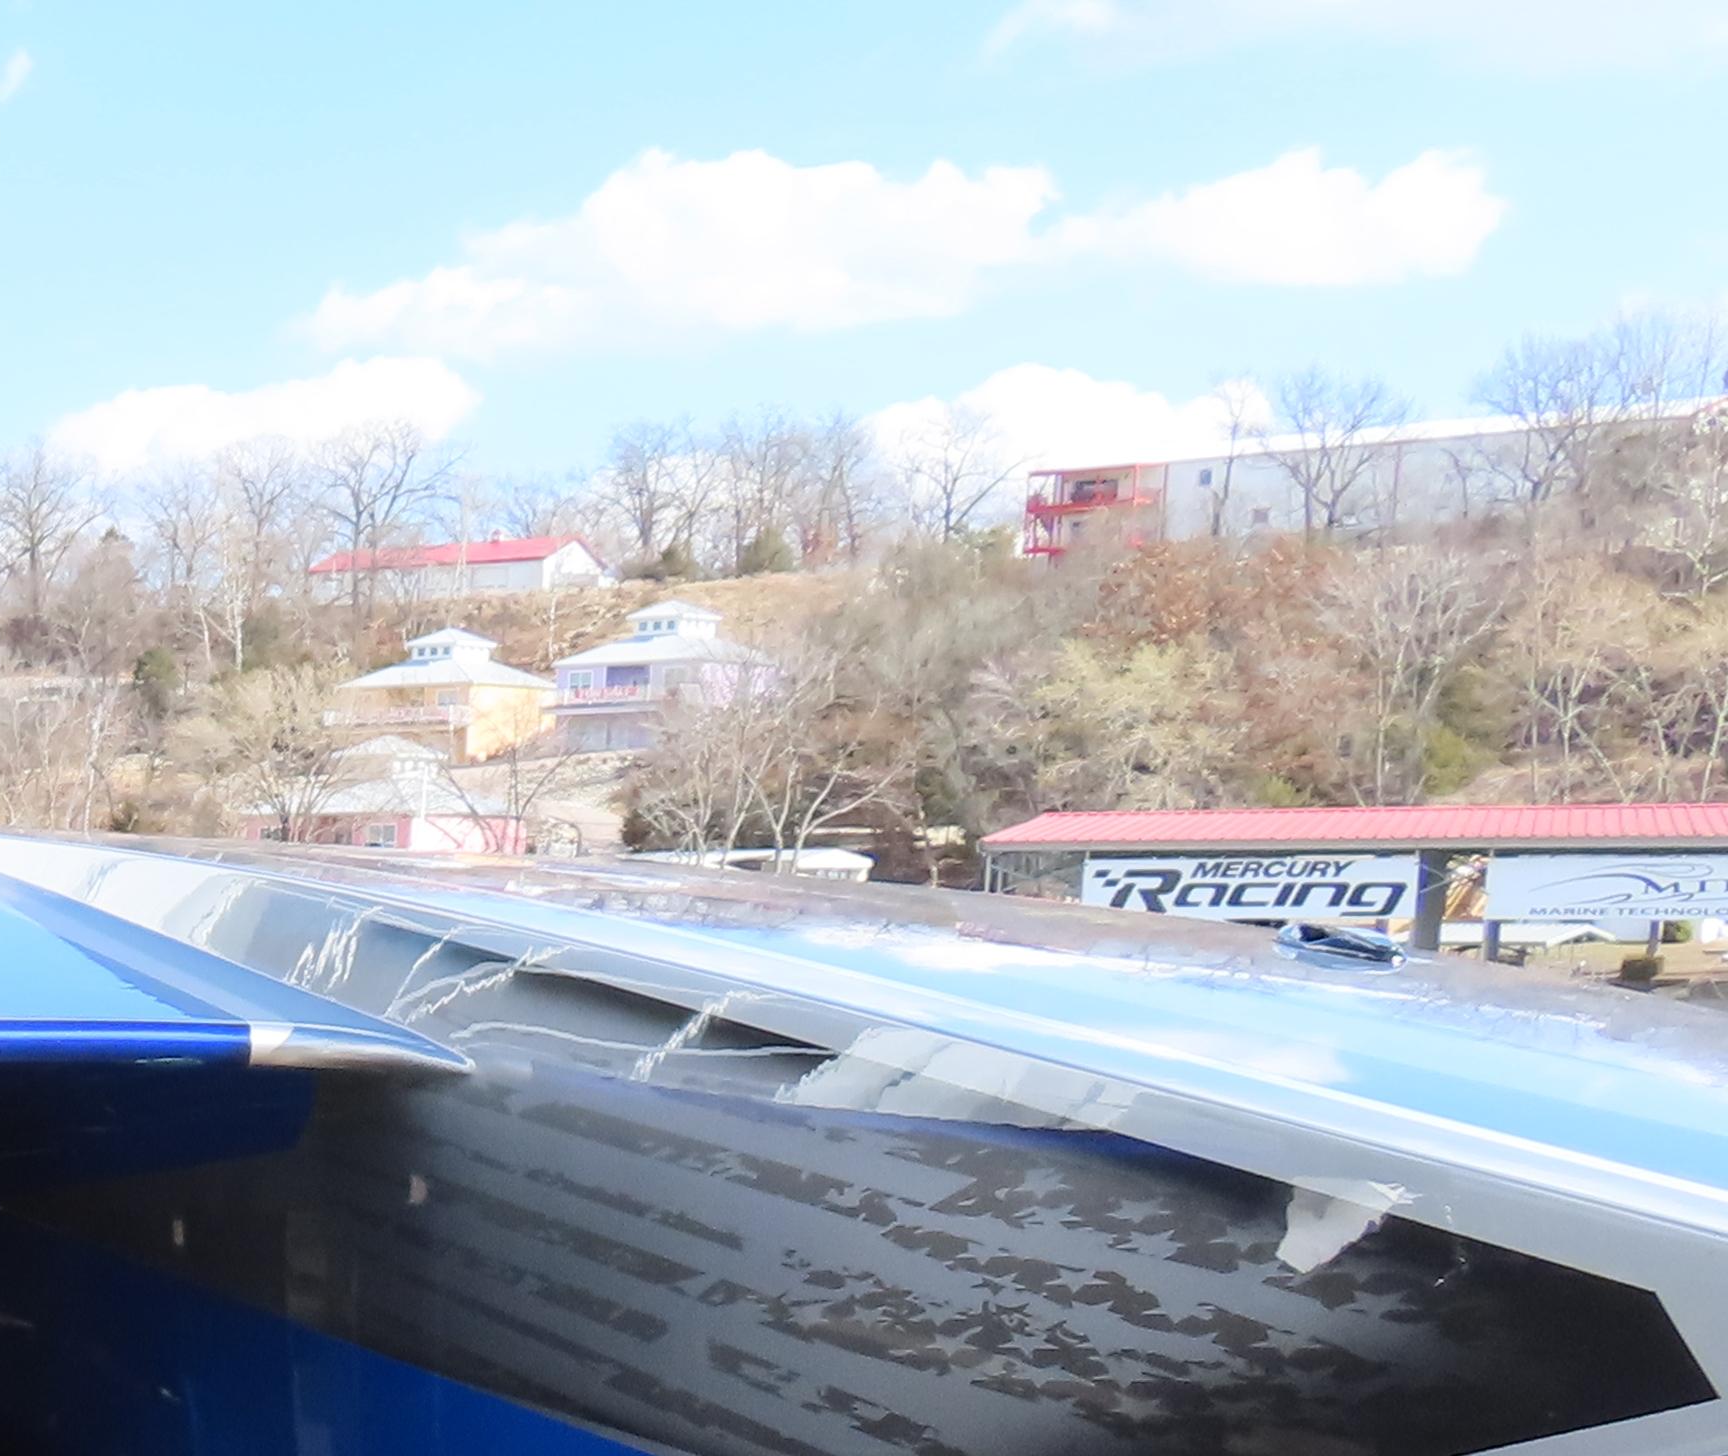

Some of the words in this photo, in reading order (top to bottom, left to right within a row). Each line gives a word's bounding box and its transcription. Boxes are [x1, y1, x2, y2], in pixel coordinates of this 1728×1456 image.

[1189, 861, 1354, 878] MERCURY
[1109, 868, 1408, 917] Racing
[1529, 907, 1610, 916] MARINE
